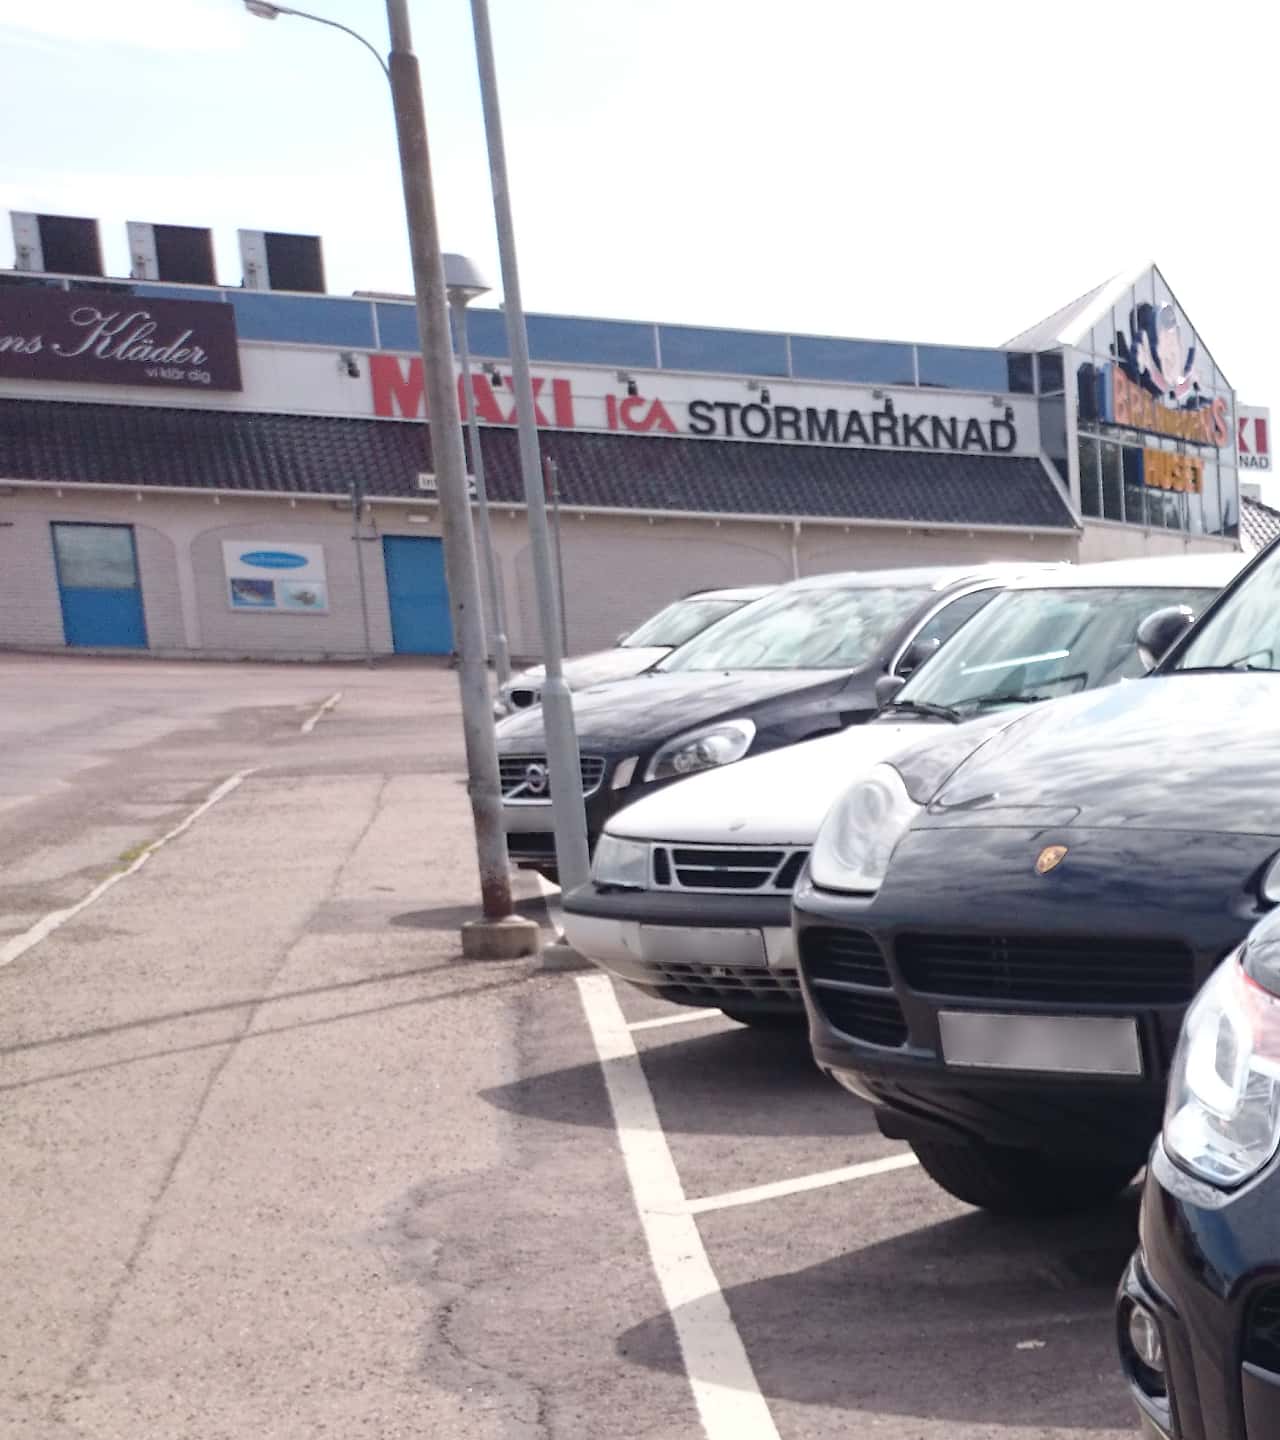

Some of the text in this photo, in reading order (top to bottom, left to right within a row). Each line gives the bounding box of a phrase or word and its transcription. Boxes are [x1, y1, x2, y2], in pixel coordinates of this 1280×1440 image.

[52, 307, 208, 365] Kläder
[605, 394, 678, 433] ICA
[688, 399, 1017, 454] STORMARKNAD
